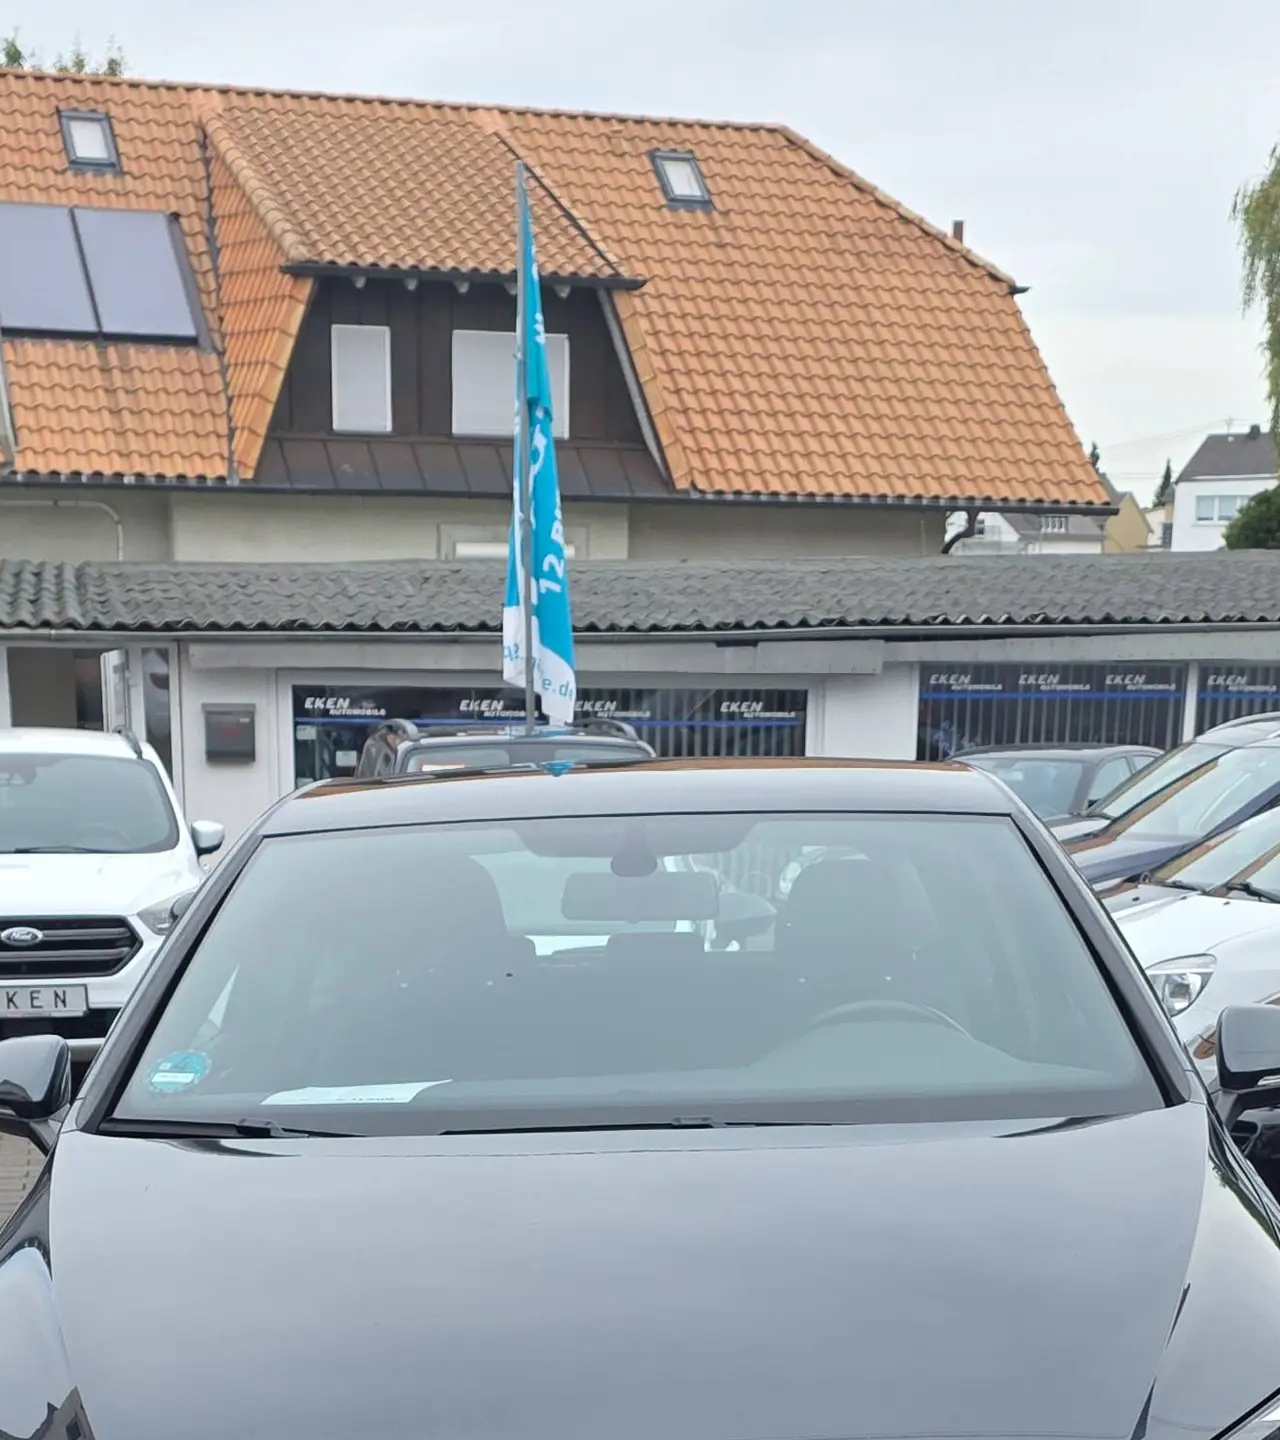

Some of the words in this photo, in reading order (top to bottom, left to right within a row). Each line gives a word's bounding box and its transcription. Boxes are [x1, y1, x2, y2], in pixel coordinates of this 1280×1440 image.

[928, 673, 972, 685] EKEN
[1017, 673, 1060, 685] EKEN
[1105, 673, 1147, 685] EKEN
[1206, 674, 1248, 685] EKEN
[303, 696, 350, 709] EKEN
[459, 699, 505, 711] EKEN
[573, 699, 617, 712] EKEN
[719, 700, 763, 712] EKEN
